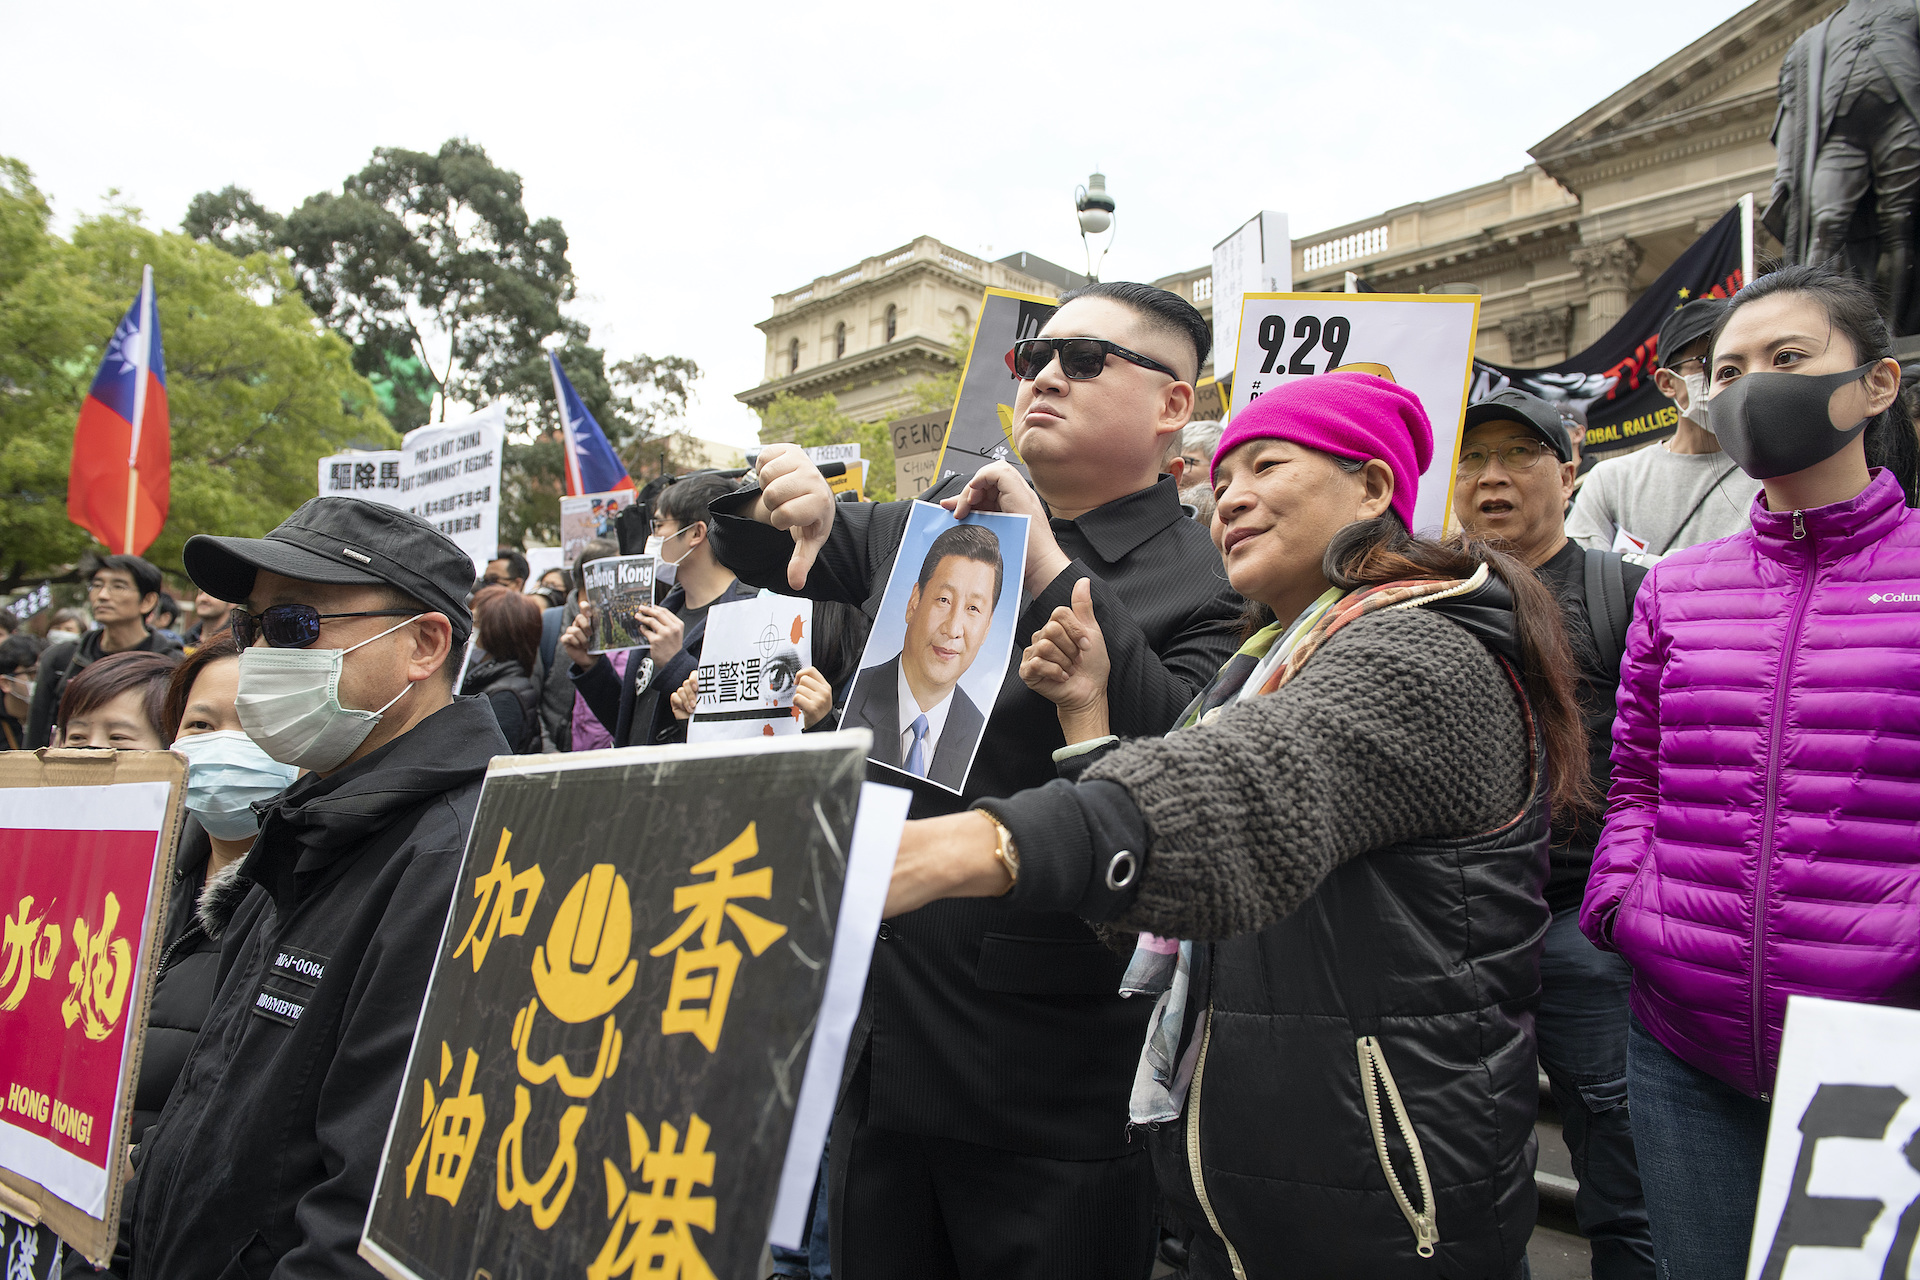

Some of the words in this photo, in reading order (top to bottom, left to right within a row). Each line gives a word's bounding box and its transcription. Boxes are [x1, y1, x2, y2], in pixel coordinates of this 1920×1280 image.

[1258, 315, 1351, 375] 9.29
[893, 420, 950, 450] GENO
[1585, 424, 1622, 446] OBAL
[1622, 405, 1679, 438] RALLIES
[414, 448, 430, 466] PRC
[430, 444, 438, 460] IS
[440, 438, 455, 457] NOT
[456, 431, 481, 453] CHINA
[329, 462, 399, 490] 驅除馬
[400, 475, 415, 492] BUT
[415, 460, 461, 488] COMMUNIST
[464, 450, 493, 474] REGIME
[593, 567, 616, 590] Hong
[617, 563, 652, 587] Kong
[696, 658, 761, 705] 黑警還
[0, 890, 132, 1043] 加油
[7, 1082, 50, 1123] HONG
[50, 1098, 94, 1146] KONG!
